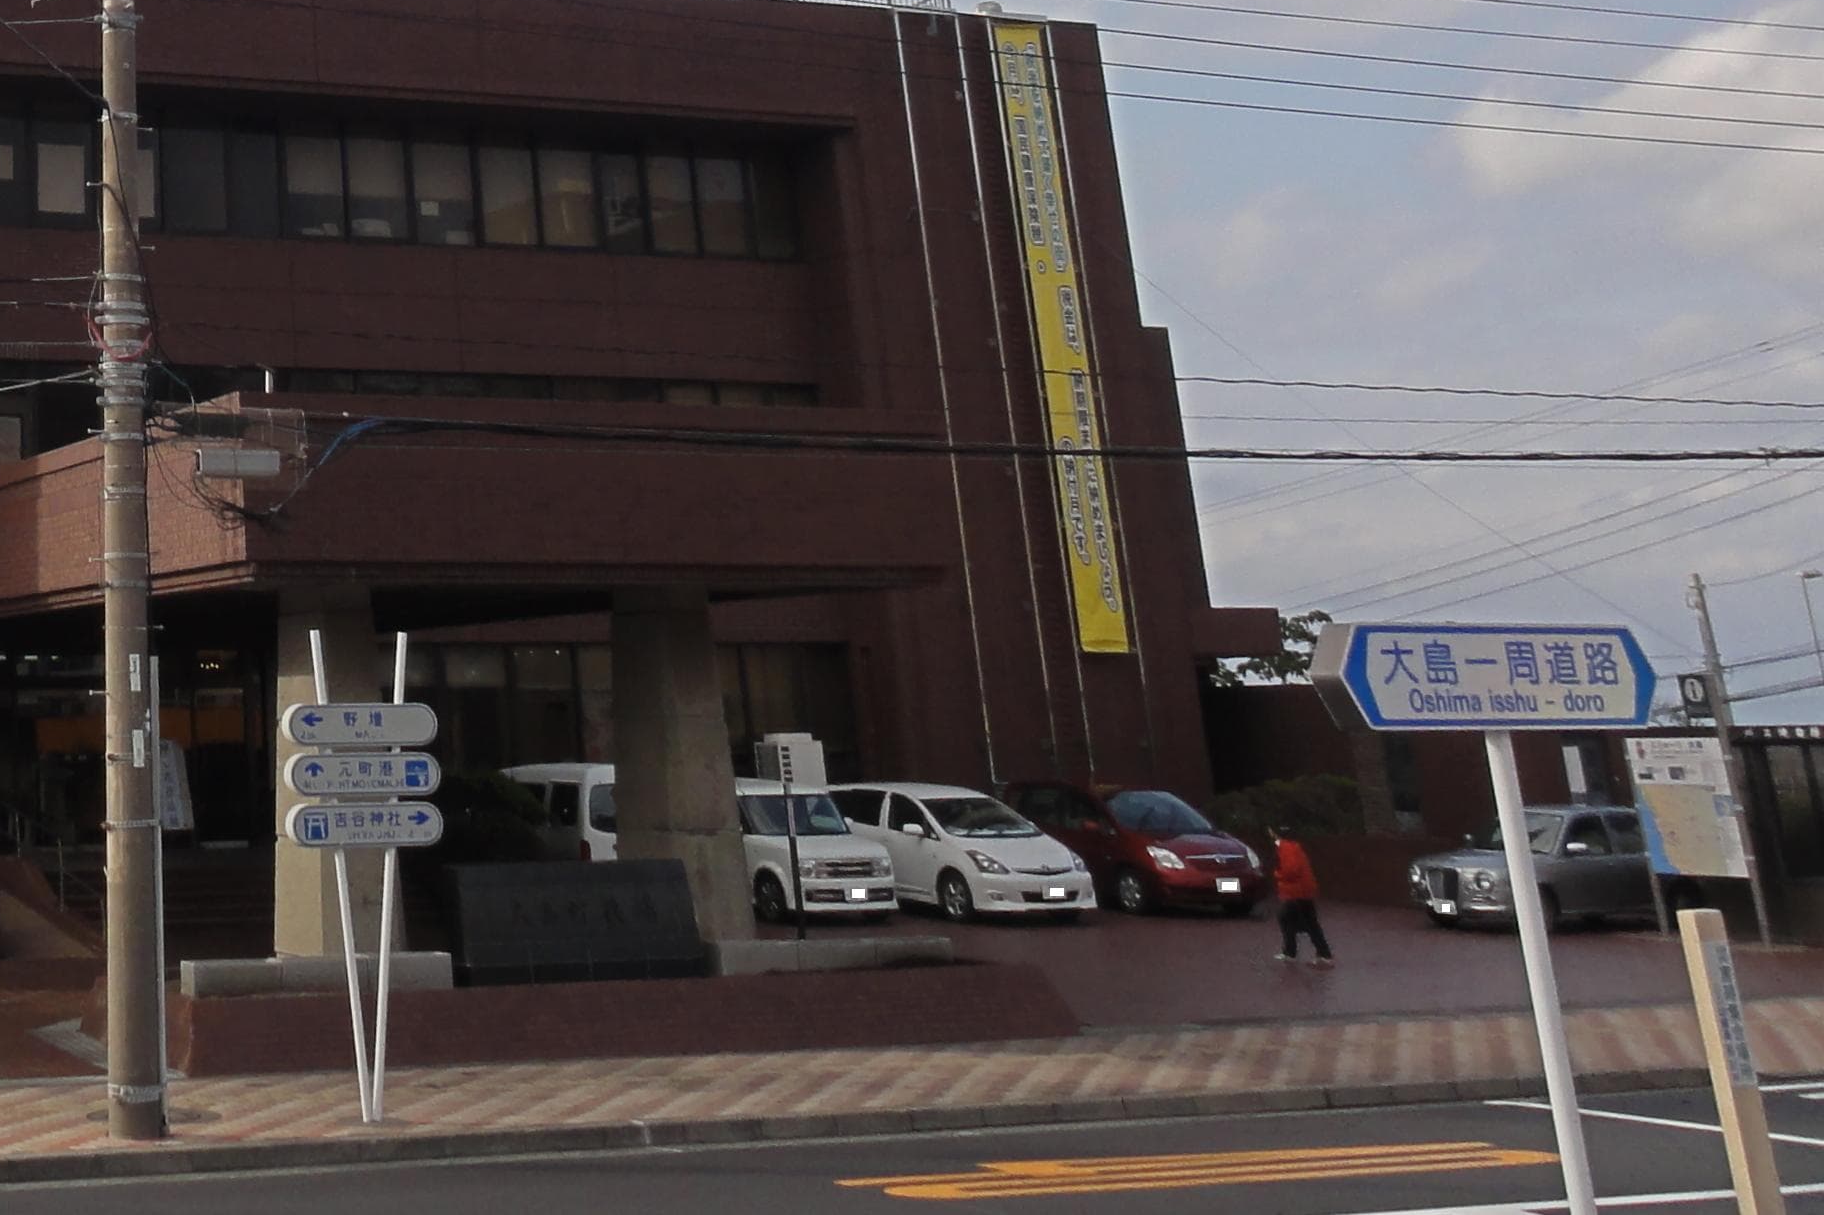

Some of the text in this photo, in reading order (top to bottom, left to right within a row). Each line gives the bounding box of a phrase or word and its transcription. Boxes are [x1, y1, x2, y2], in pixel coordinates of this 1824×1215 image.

[1380, 639, 1619, 686] 大島一周道路
[1409, 689, 1482, 713] Oshima
[1488, 690, 1539, 713] isshu
[1563, 691, 1605, 713] doro
[338, 760, 394, 777] 元町港
